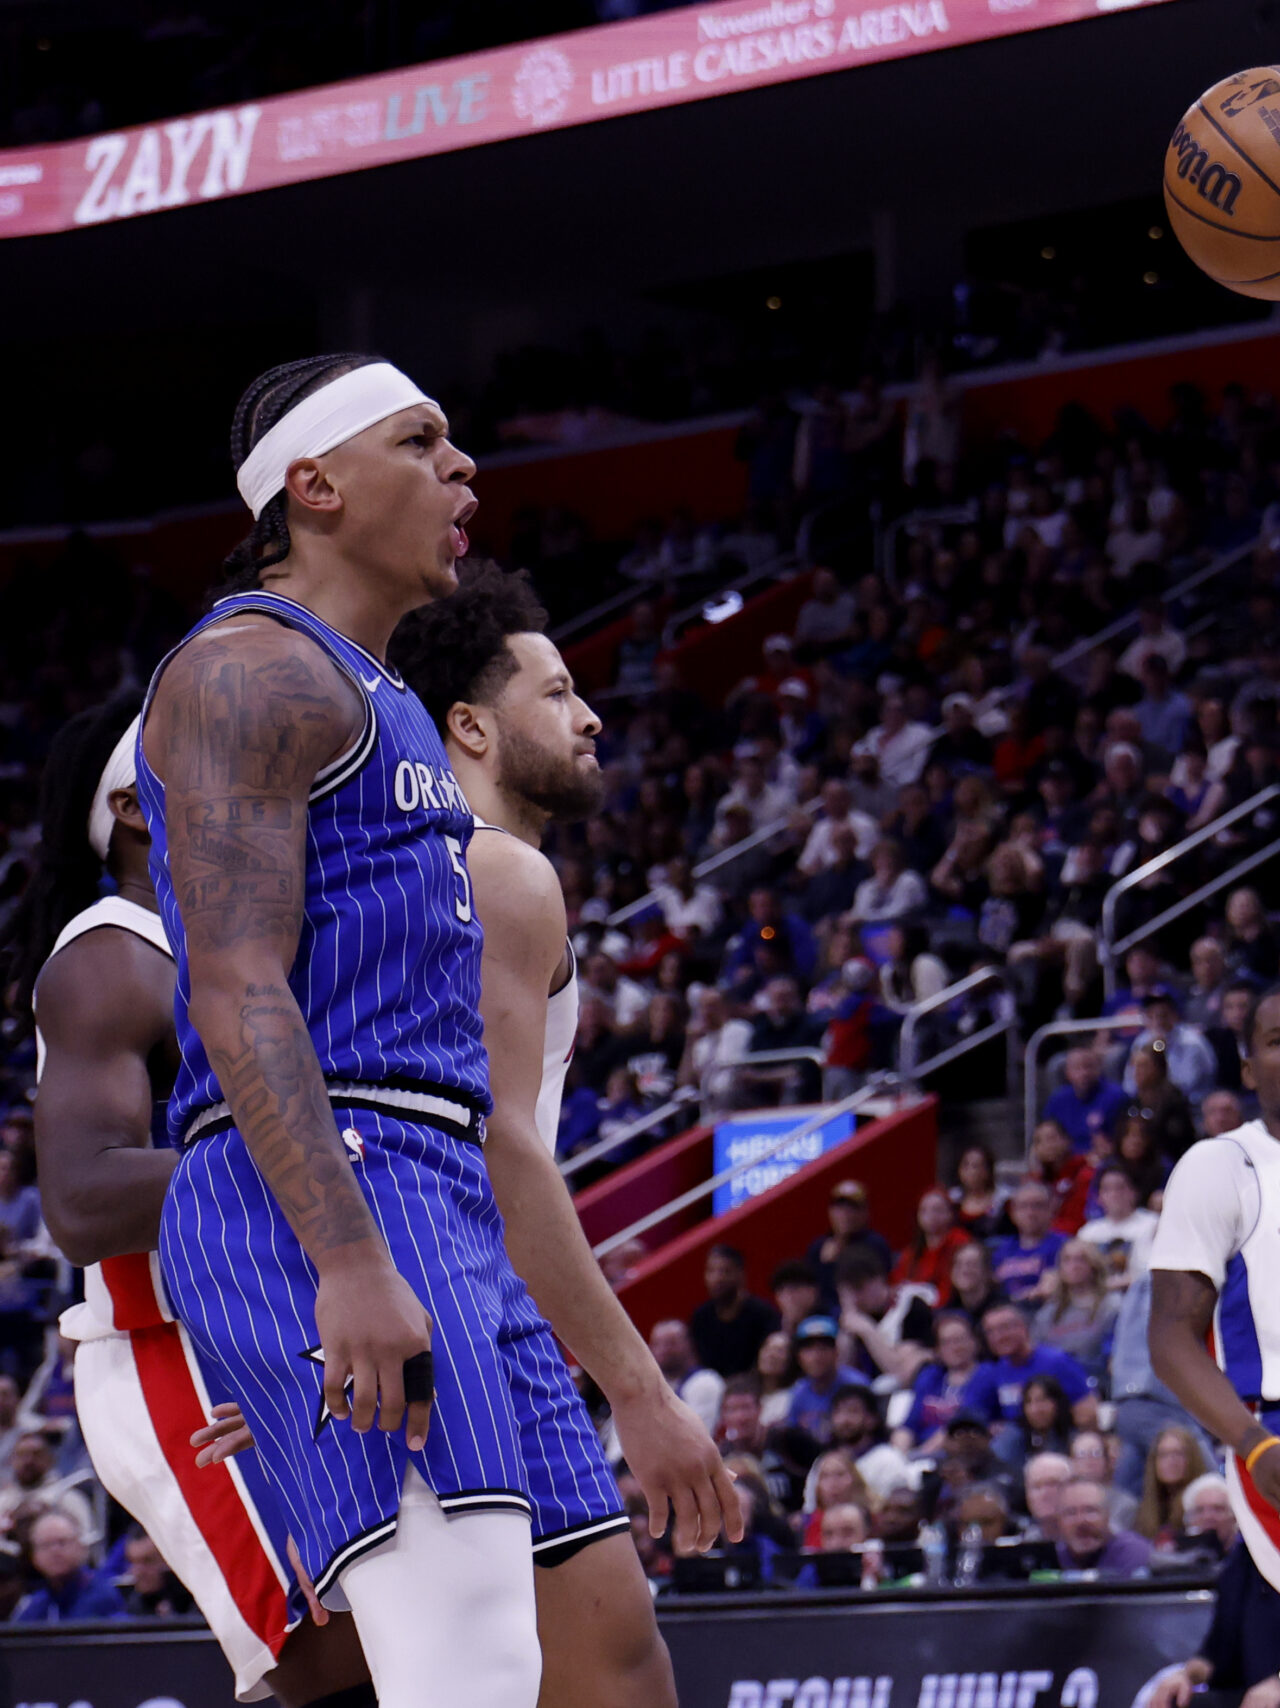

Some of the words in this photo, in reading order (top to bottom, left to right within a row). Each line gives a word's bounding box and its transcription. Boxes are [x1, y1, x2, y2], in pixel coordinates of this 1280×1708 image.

[591, 53, 688, 104] LITTLE
[694, 19, 836, 82] CAESARS
[838, 0, 950, 54] ARENA
[74, 104, 262, 224] ZAYN
[442, 834, 472, 923] 5
